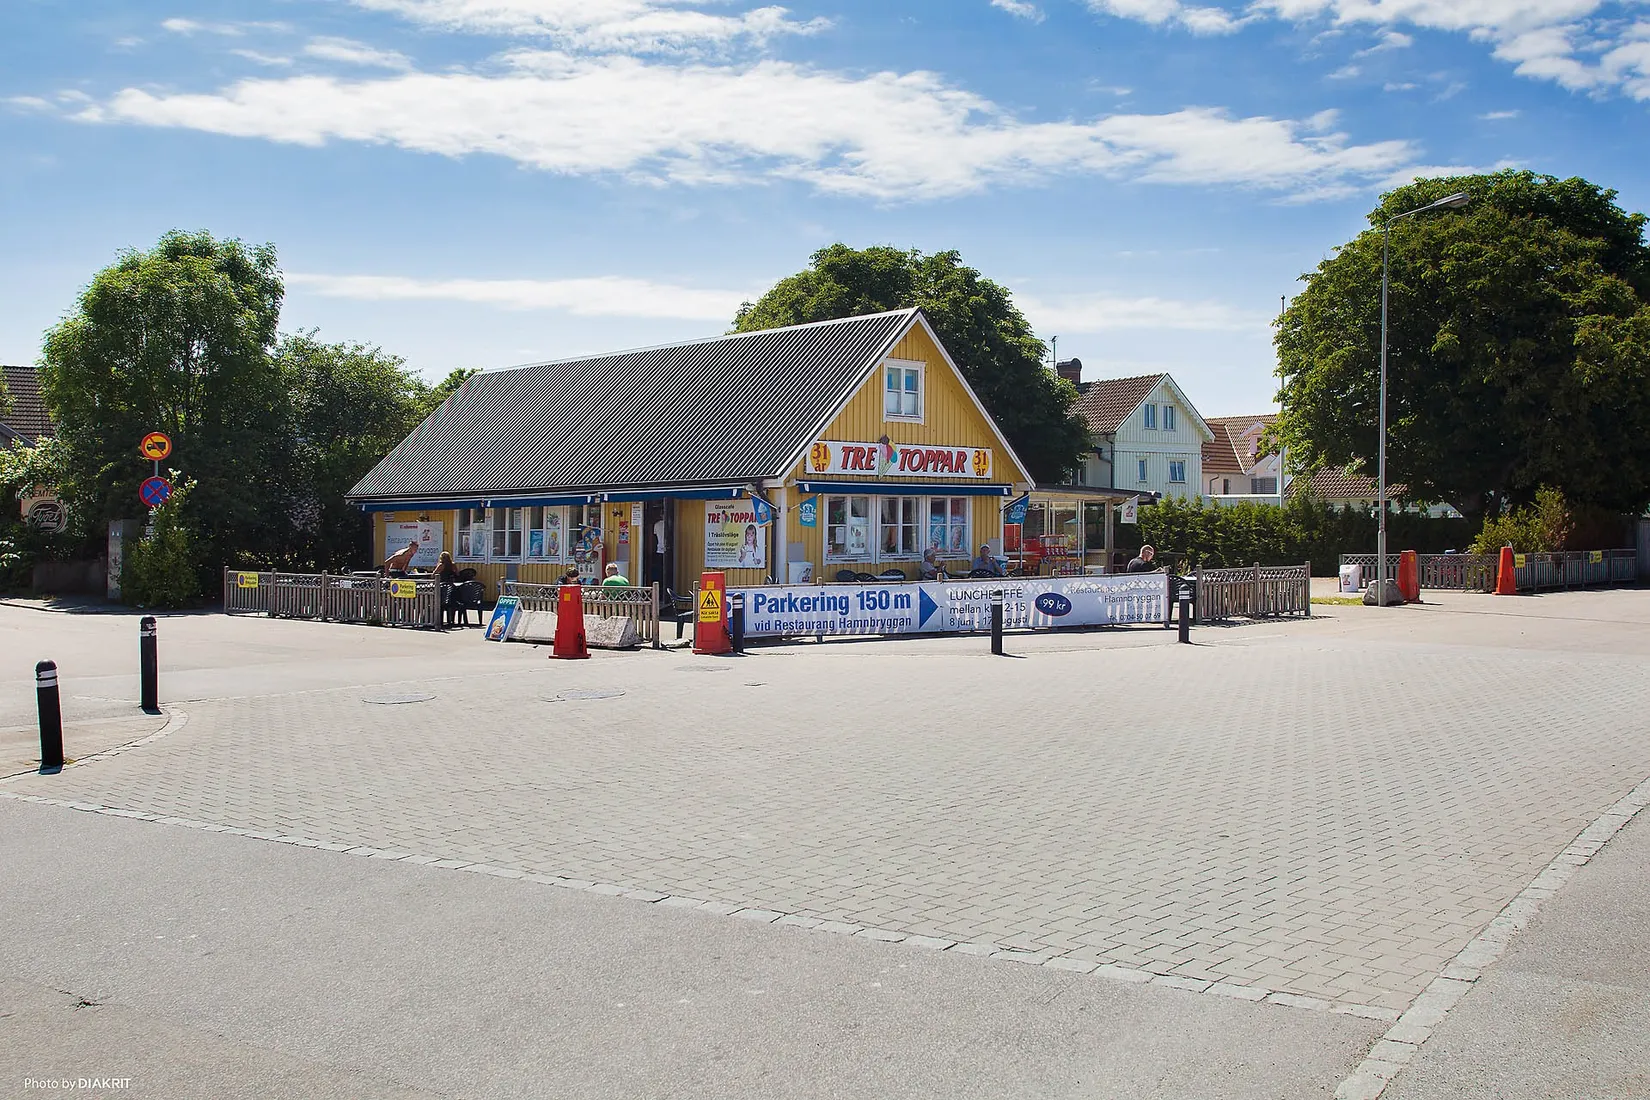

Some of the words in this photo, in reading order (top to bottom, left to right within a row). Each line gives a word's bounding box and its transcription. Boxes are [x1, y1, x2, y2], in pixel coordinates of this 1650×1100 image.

[812, 442, 828, 460] 31
[840, 446, 878, 470] TRE
[898, 448, 968, 473] TOPPAR
[974, 450, 987, 466] 31
[814, 459, 827, 472] år
[976, 465, 986, 477] år
[708, 512, 721, 523] TRE
[730, 512, 758, 523] TOPPA
[754, 592, 849, 615] Parkering
[856, 590, 889, 610] 150
[894, 593, 911, 609] m
[1042, 598, 1054, 608] 99
[1056, 600, 1066, 610] kr
[1104, 594, 1161, 604] Hamnbryggan
[950, 603, 981, 614] mellan
[1003, 602, 1026, 612] 2-15
[754, 620, 770, 631] vid
[775, 619, 834, 631] Restaurang
[839, 617, 911, 630] Hamnbryggan
[949, 617, 955, 626] 8
[957, 617, 974, 628] juni
[1003, 615, 1027, 627] ugusti
